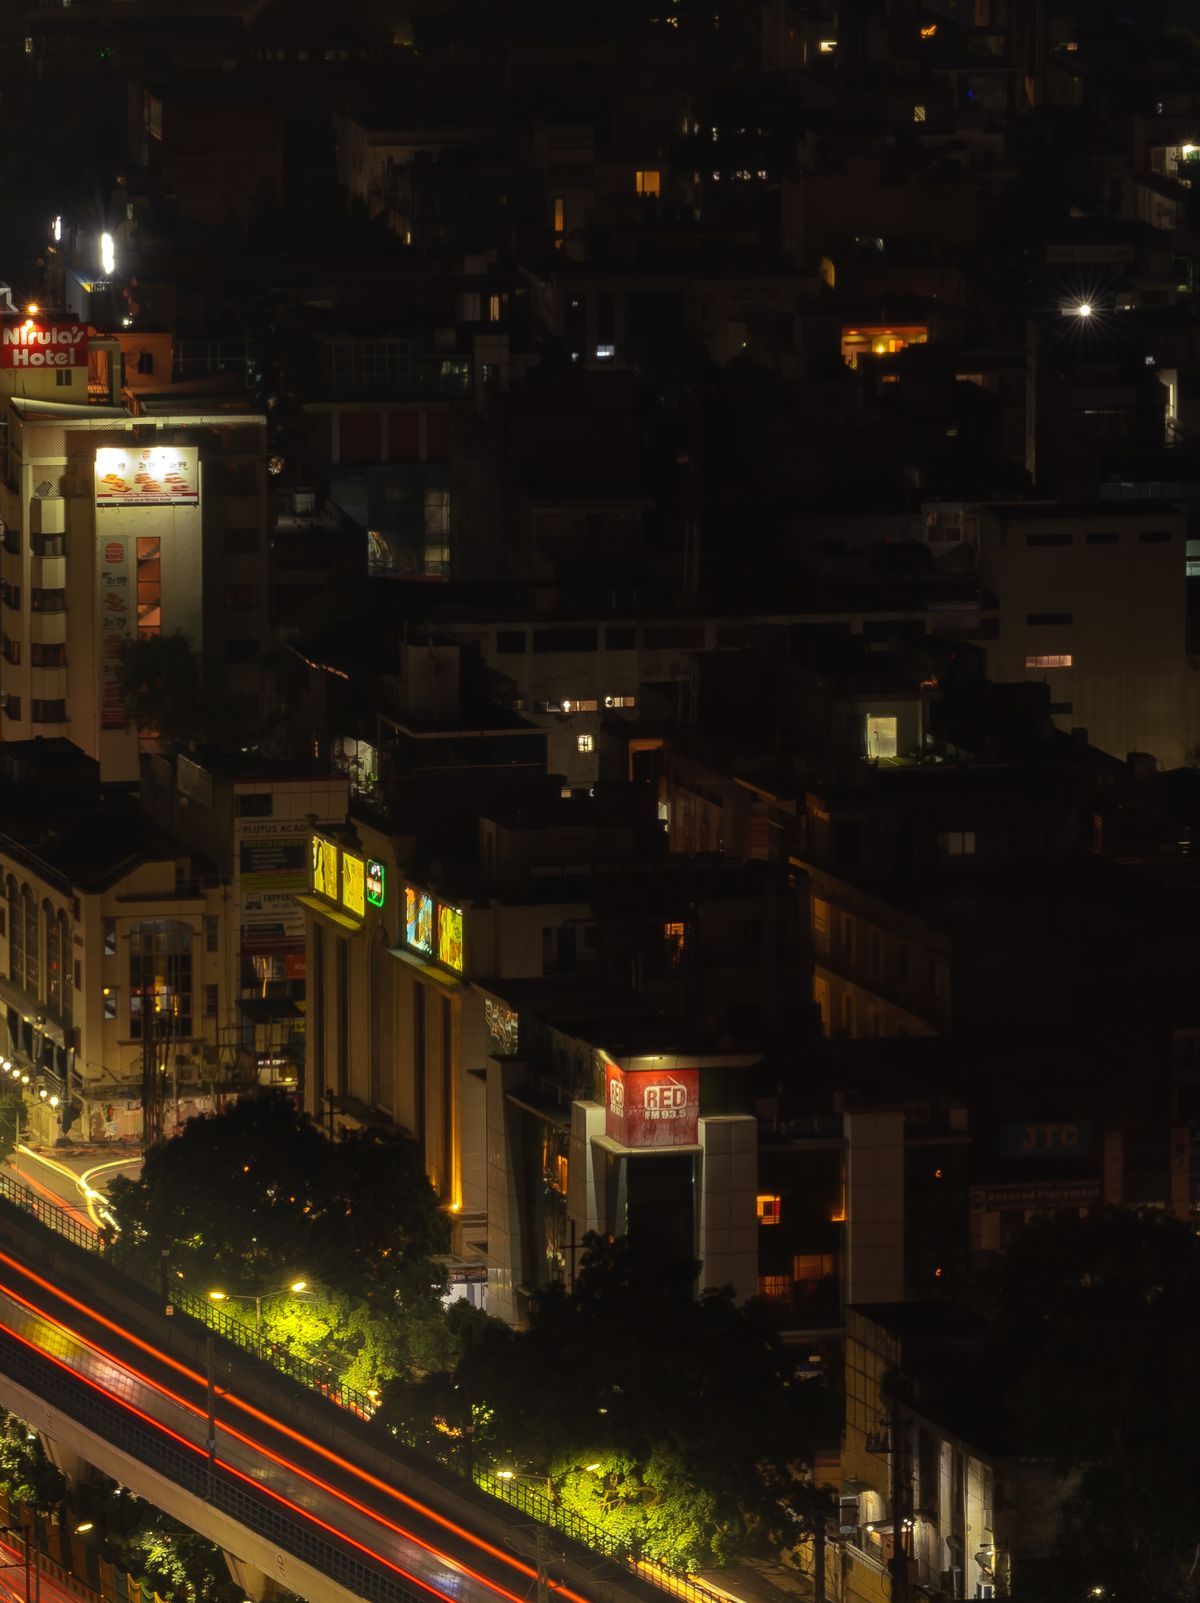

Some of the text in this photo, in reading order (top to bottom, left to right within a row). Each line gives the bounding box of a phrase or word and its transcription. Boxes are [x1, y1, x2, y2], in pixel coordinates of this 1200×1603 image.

[2, 326, 84, 345] Nirula's
[12, 348, 75, 366] Hotel
[243, 825, 278, 834] PLUTUS
[644, 1085, 687, 1111] RED
[644, 1109, 687, 1120] FM 93.5
[1023, 1123, 1080, 1149] JTC
[987, 1188, 1101, 1201] Assured Placement
